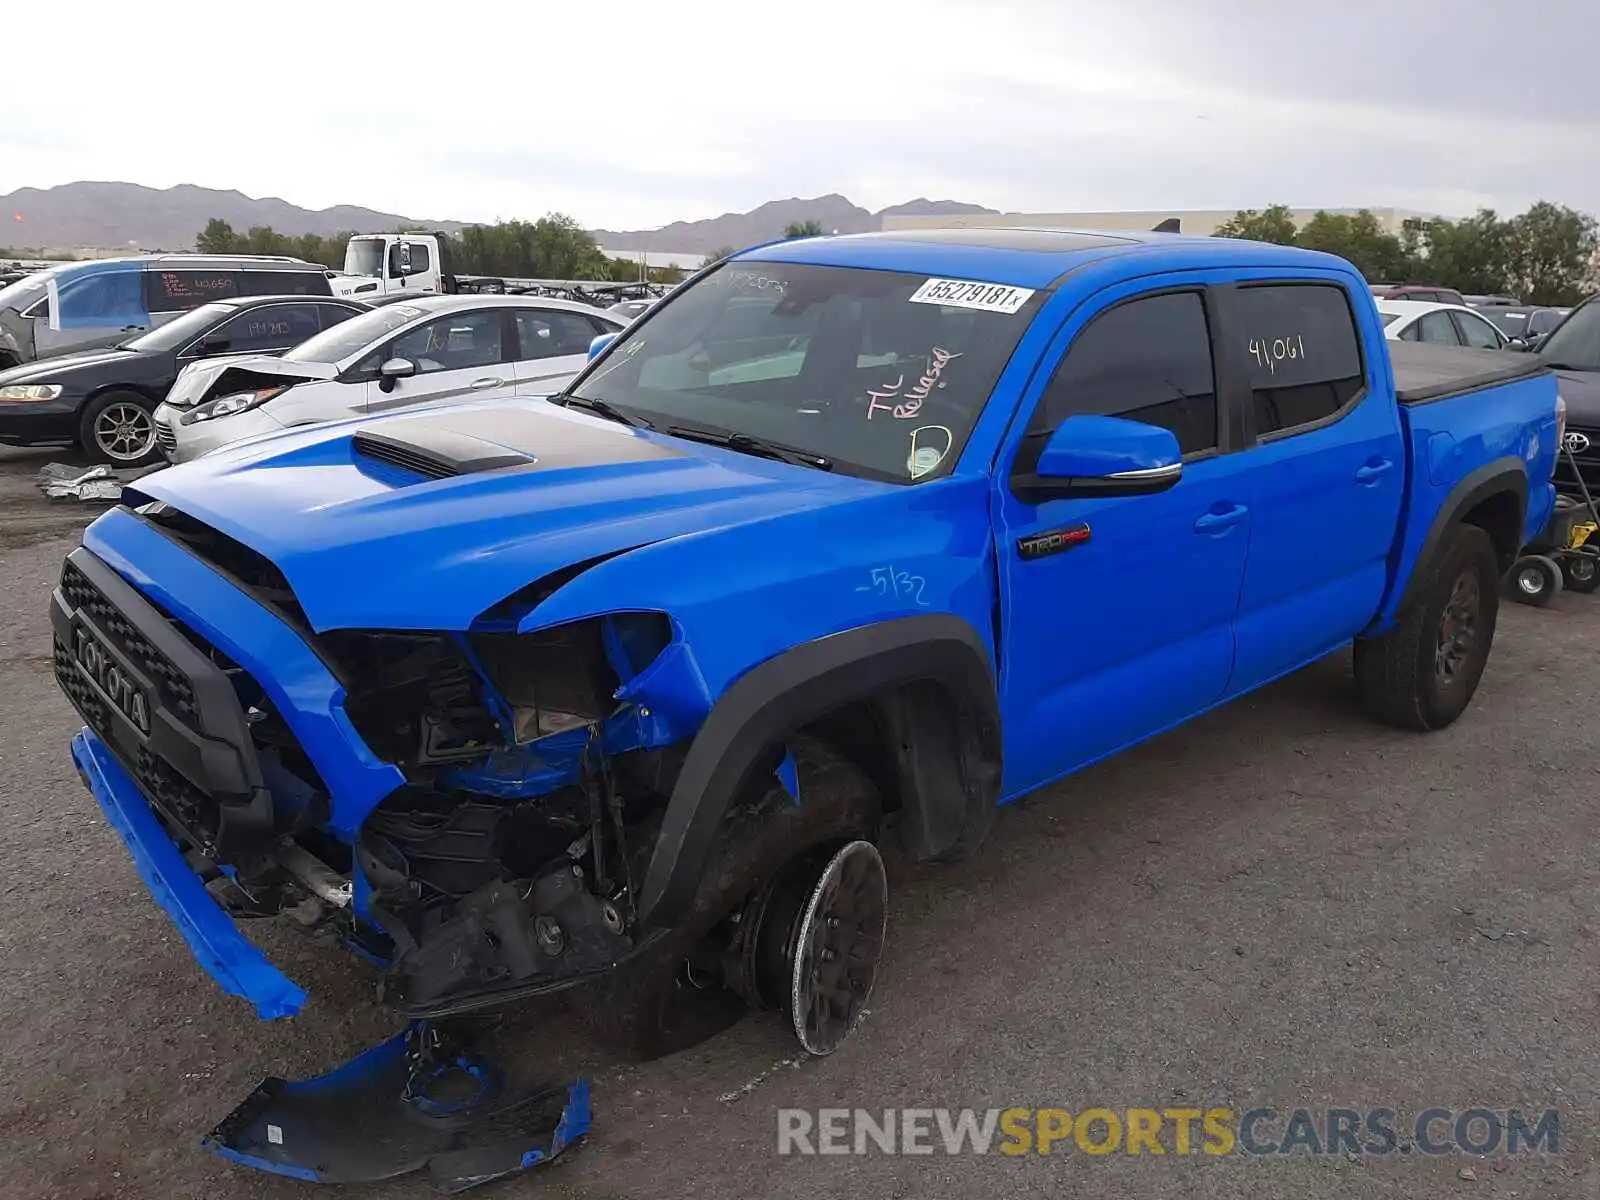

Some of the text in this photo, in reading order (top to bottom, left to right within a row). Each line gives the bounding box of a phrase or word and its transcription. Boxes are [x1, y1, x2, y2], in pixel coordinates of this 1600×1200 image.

[927, 281, 1017, 305] 55279181
[1249, 335, 1305, 375] 41,061
[76, 628, 150, 731] TOYOTA
